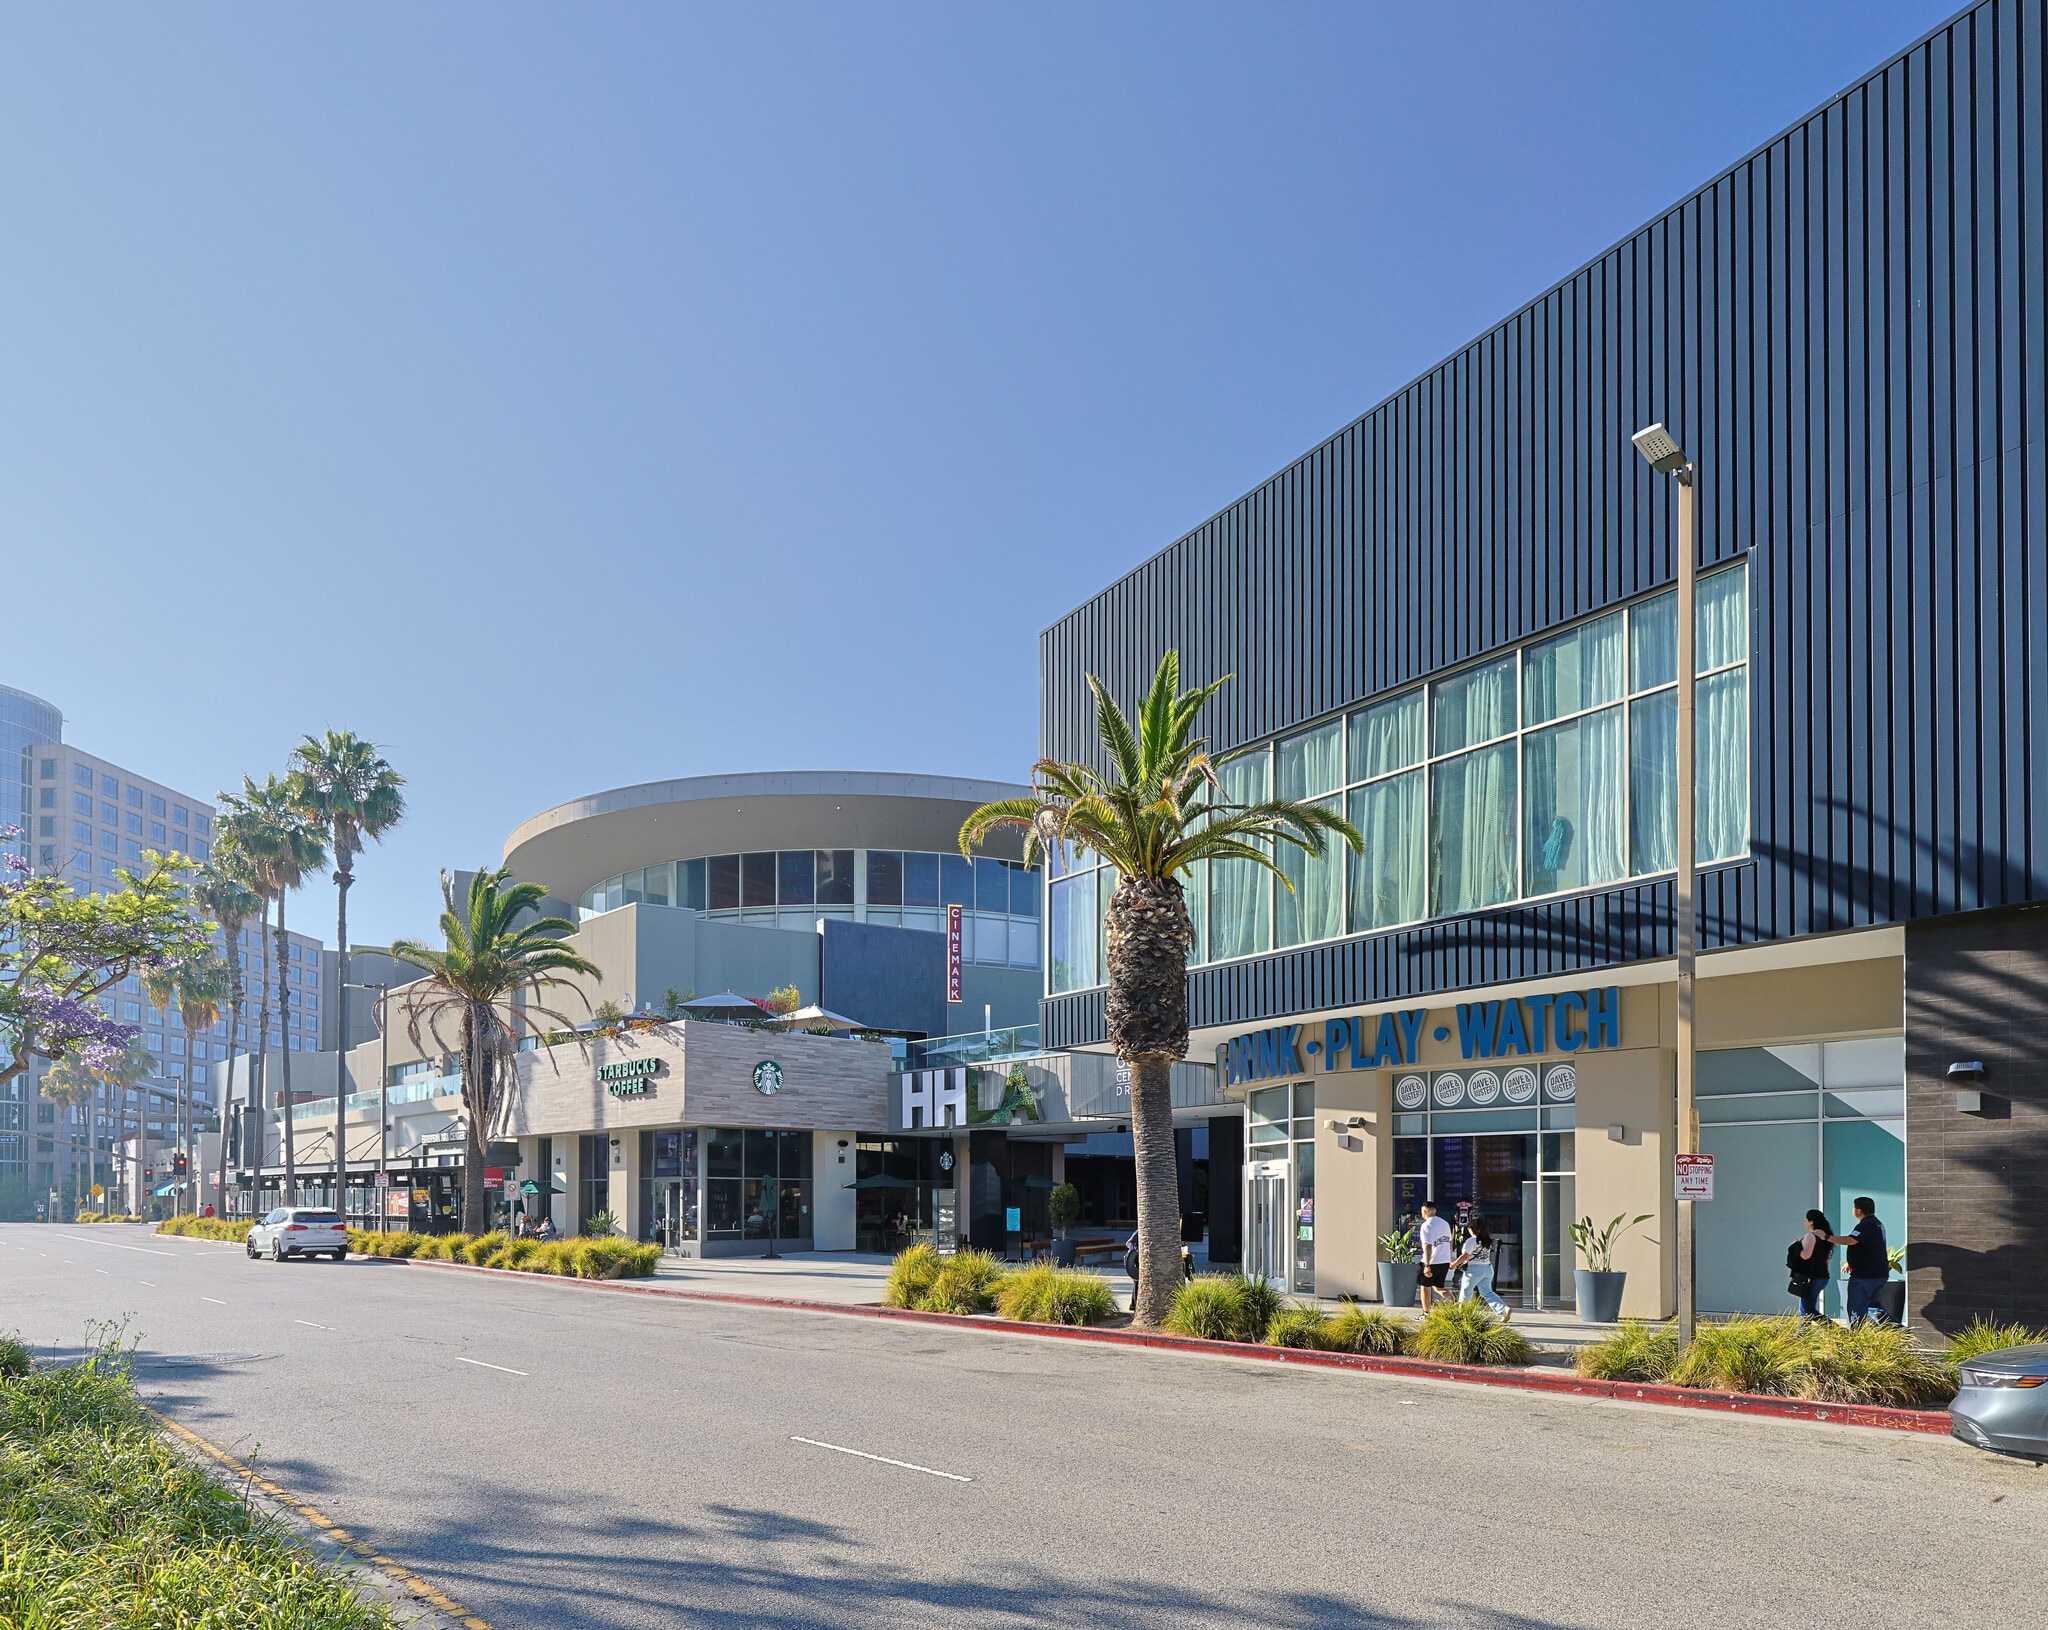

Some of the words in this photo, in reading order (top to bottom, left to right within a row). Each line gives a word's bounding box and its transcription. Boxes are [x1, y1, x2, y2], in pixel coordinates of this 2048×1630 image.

[951, 908, 960, 999] CINEMARK
[1228, 1023, 1301, 1085] DRINK
[1325, 1008, 1427, 1071] PLAY
[1456, 986, 1619, 1059] WATCH
[597, 1057, 656, 1081] STARBUCKS
[608, 1078, 644, 1096] COFFEE
[902, 1062, 1039, 1129] HHLA
[1677, 1164, 1688, 1175] NO
[1689, 1165, 1712, 1174] STOPPING
